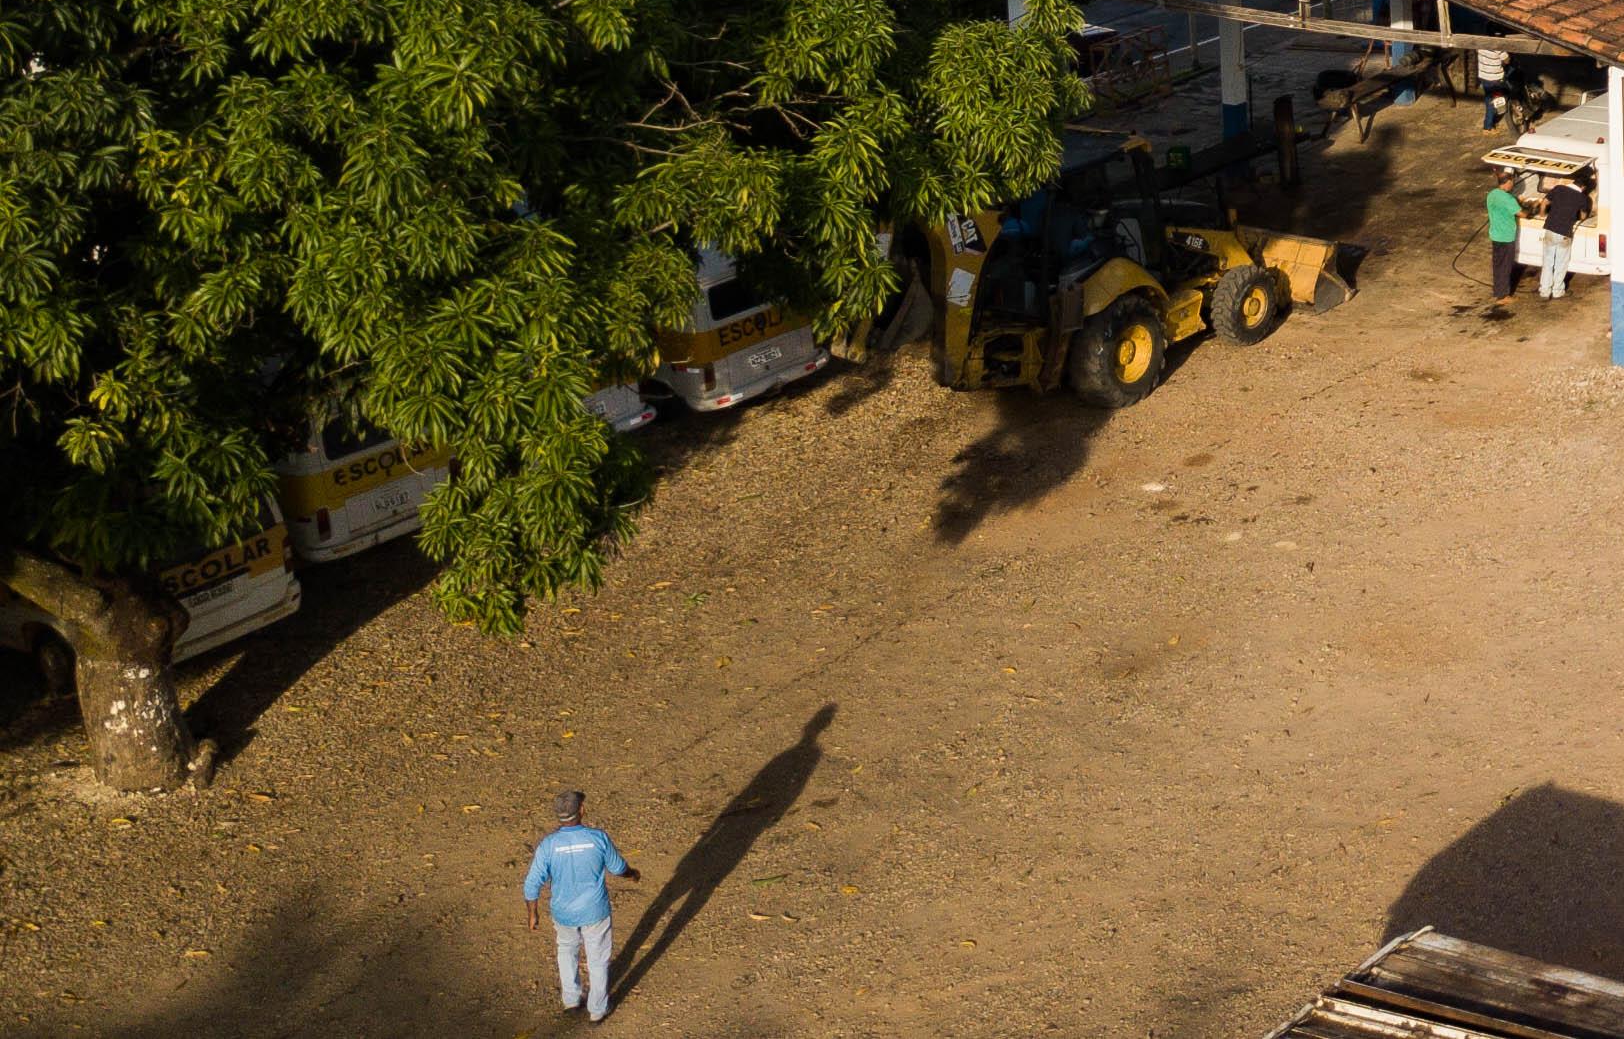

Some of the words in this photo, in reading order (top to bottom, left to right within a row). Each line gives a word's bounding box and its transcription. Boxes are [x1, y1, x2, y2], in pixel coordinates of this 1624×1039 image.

[1488, 152, 1579, 171] ESCOLAR
[960, 218, 979, 245] CAT
[718, 307, 784, 347] ESCOL
